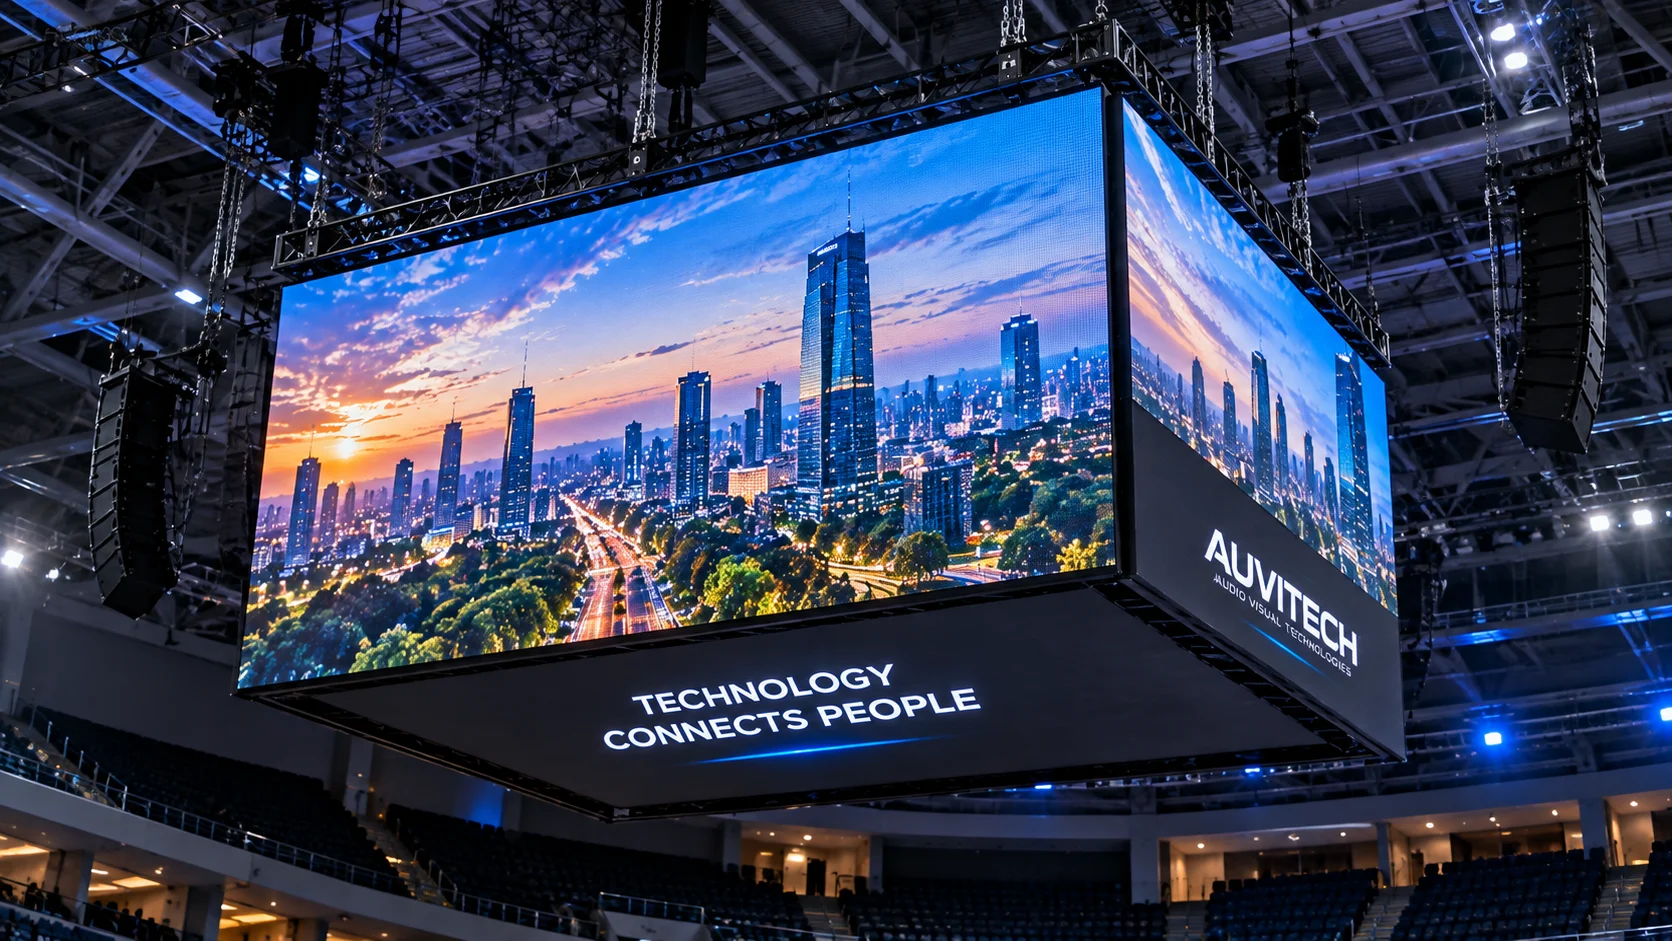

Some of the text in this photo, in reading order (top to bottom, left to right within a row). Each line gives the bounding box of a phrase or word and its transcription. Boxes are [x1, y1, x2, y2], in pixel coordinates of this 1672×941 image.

[1204, 528, 1358, 667] AUVITECH
[1214, 573, 1352, 677] AUDIO VISUAL TECHNOLOGIES
[603, 688, 982, 750] CONNECTS PEOPLE
[631, 663, 894, 715] TECHNOLOGY
